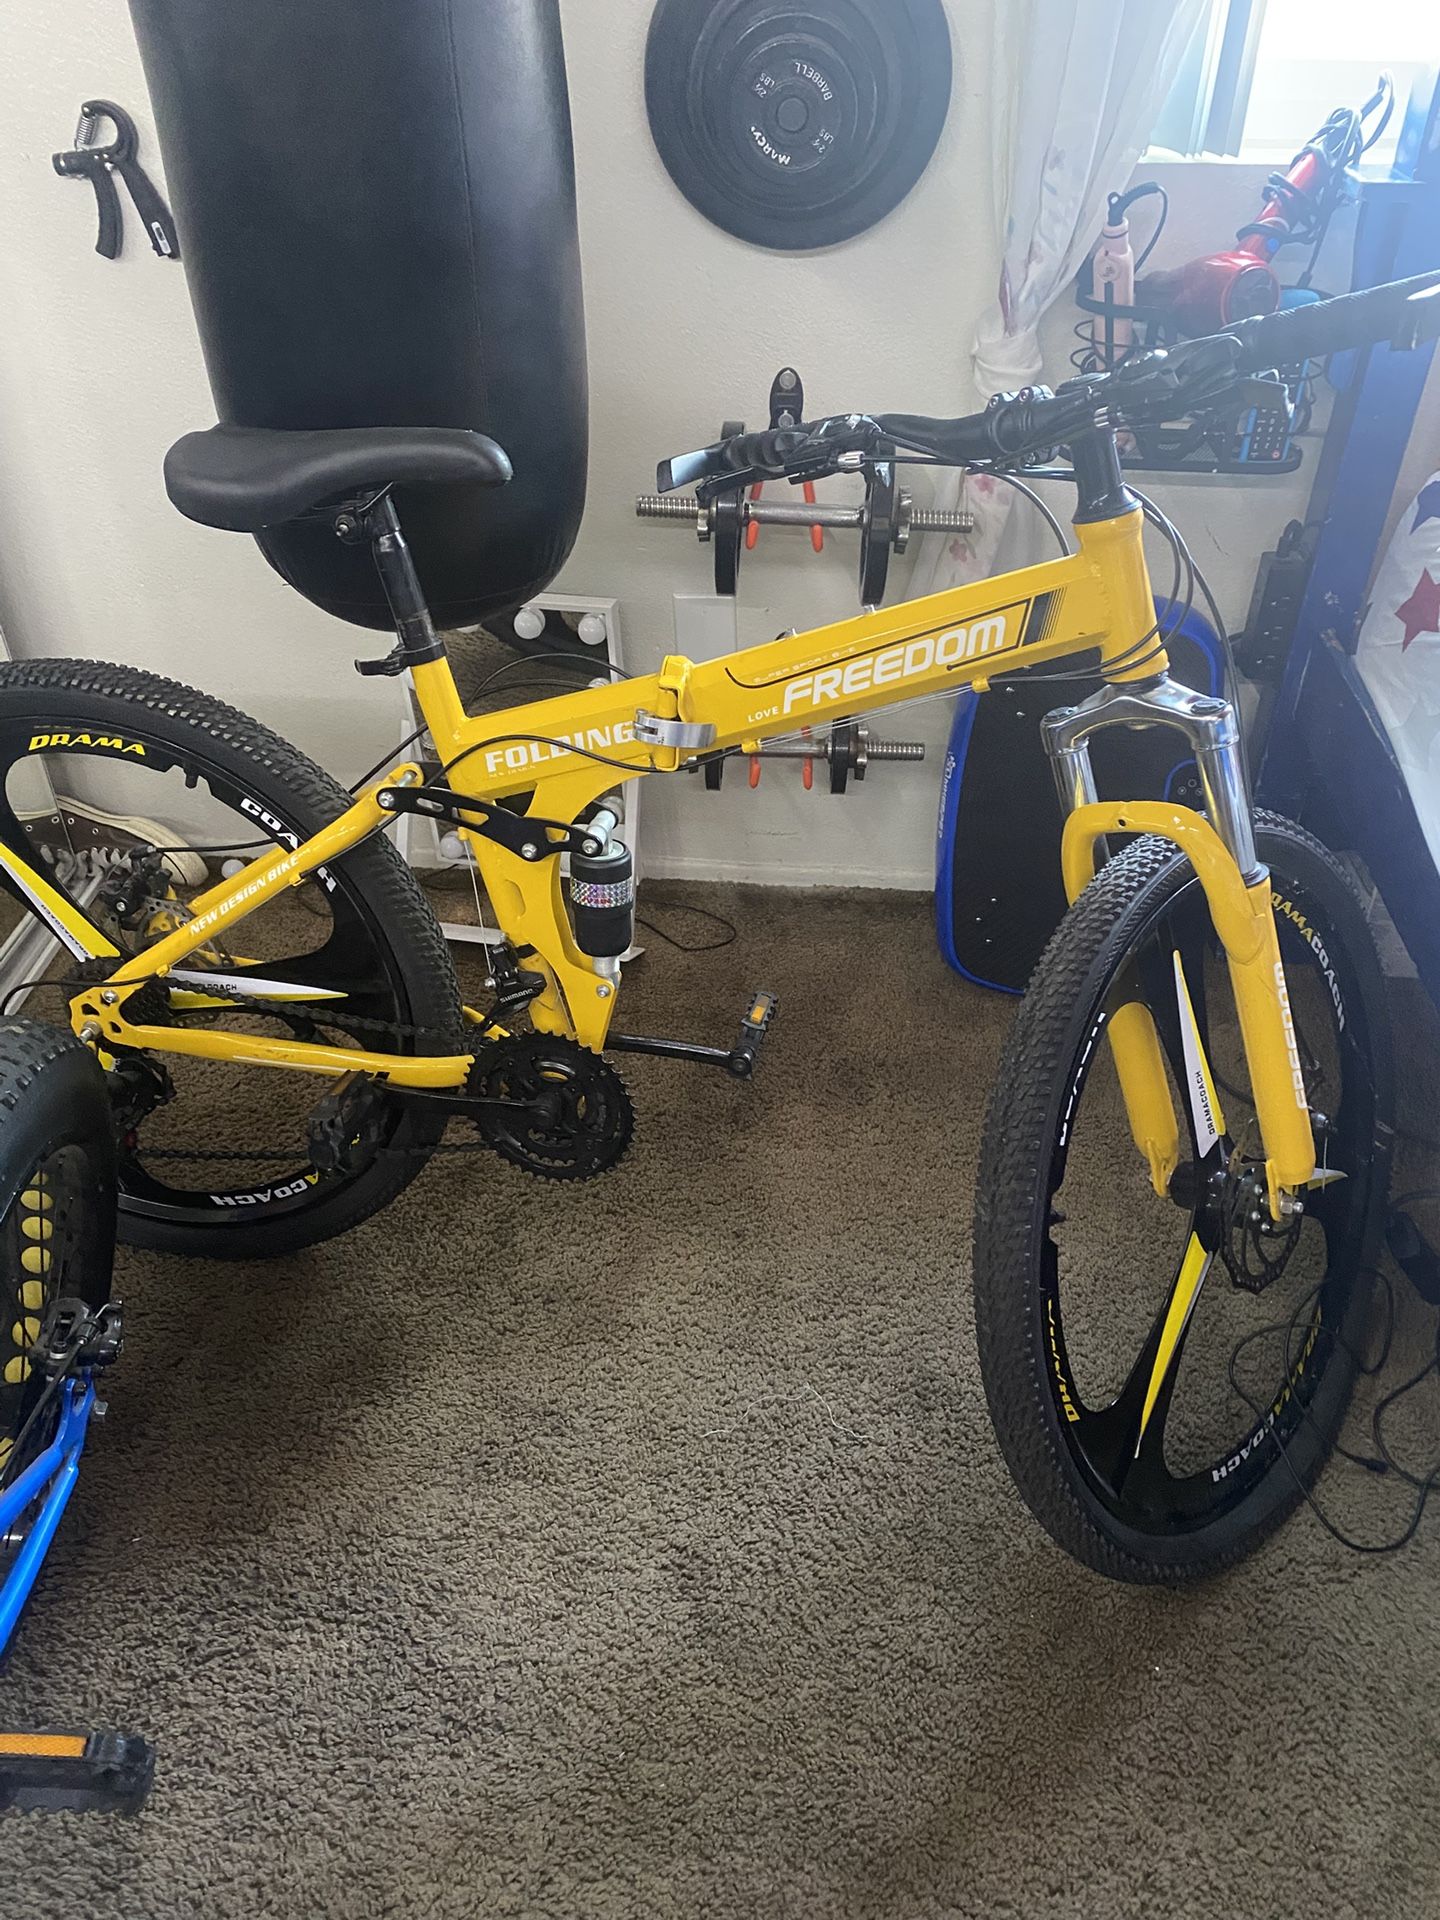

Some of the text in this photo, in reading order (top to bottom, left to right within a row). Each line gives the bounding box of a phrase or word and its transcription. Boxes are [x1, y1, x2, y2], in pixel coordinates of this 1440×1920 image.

[760, 72, 775, 89] LBS
[795, 62, 833, 101] BARBELL
[752, 130, 791, 165] MARCY
[818, 128, 835, 145] LBS
[783, 615, 1006, 715] FREEDOM
[747, 705, 779, 723] LOVE
[28, 733, 146, 756] DRAMA
[485, 720, 636, 773] FOLDING
[240, 798, 337, 893] COAH
[189, 855, 299, 936] NEW DESIGN BIKE
[1195, 1070, 1216, 1136] DRAMACOACH
